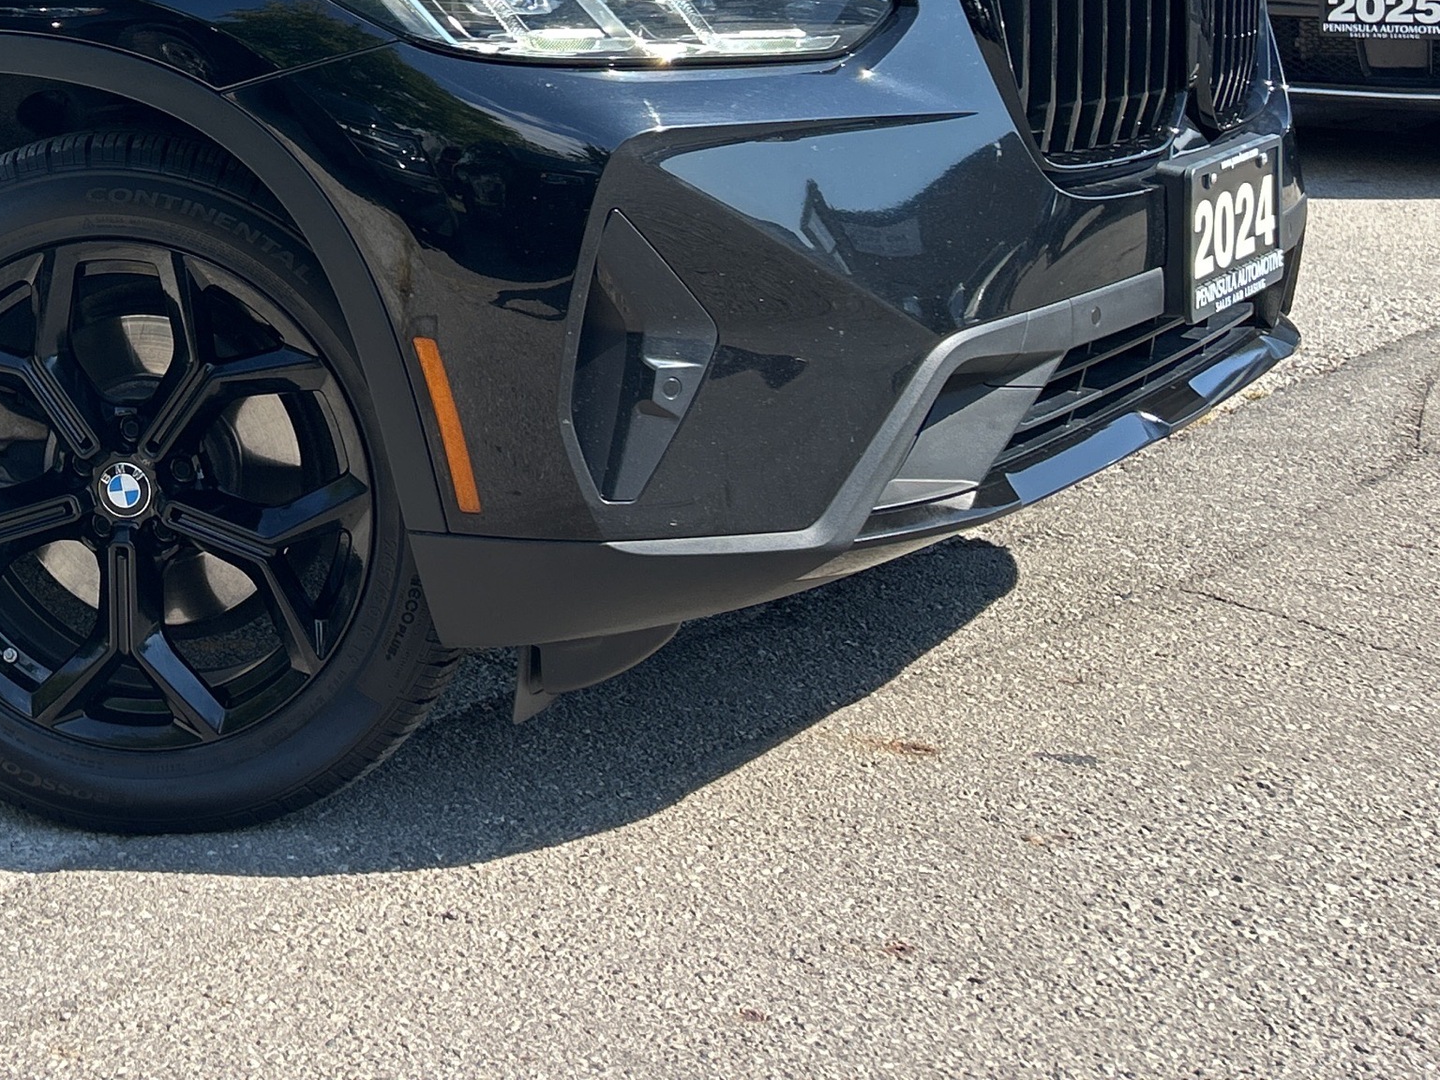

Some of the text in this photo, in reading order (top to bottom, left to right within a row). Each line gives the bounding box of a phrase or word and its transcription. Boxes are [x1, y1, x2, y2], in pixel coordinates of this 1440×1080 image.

[1323, 23, 1440, 35] PENINSULA AUTOMOTIV
[85, 186, 310, 285] CONTINENTAL
[1194, 173, 1276, 280] 2024
[1195, 248, 1284, 310] PENINSULA AUTOMOTIVE
[100, 464, 144, 485] BMW
